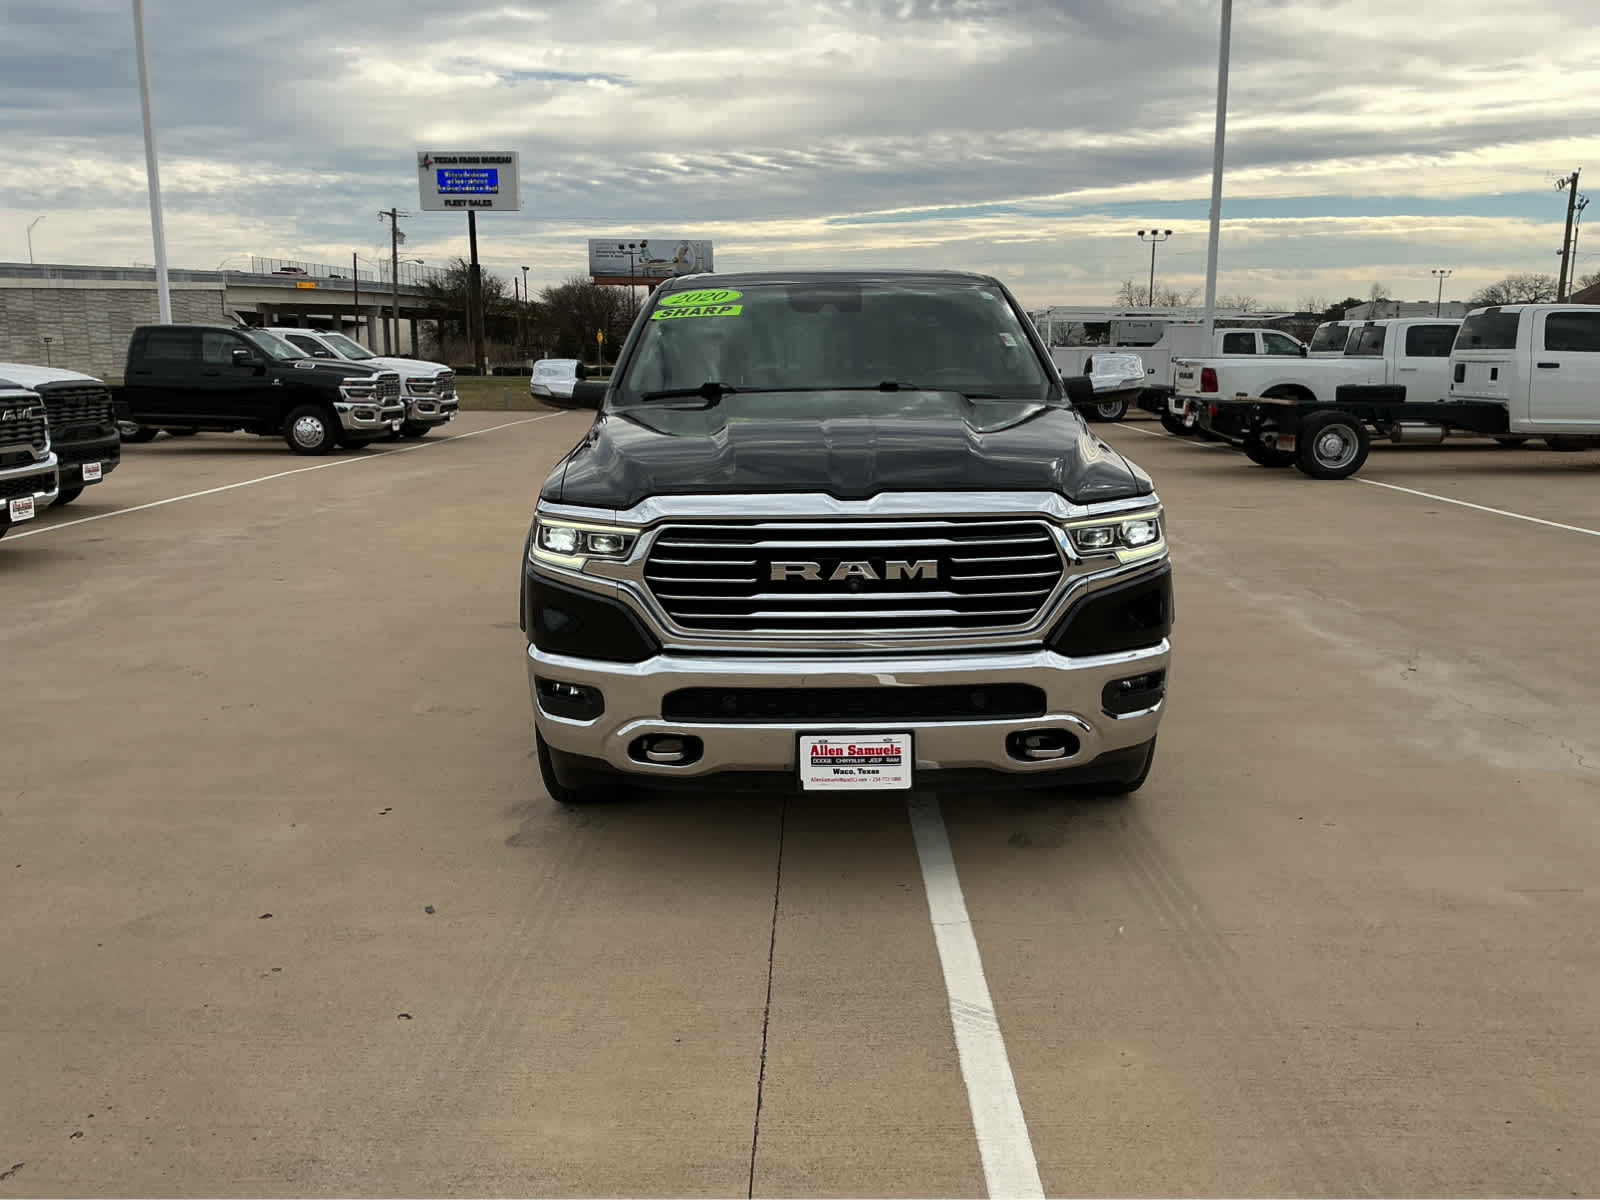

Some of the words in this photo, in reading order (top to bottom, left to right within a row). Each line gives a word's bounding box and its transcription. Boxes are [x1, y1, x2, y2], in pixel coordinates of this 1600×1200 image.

[433, 156, 457, 164] TEXAS
[458, 156, 480, 164] FARM
[481, 156, 512, 164] BUREAU
[671, 291, 729, 304] 2020
[659, 306, 733, 318] SHARP
[770, 560, 938, 581] RAM
[810, 744, 844, 756] Allen
[847, 743, 902, 756] Samuels
[832, 768, 856, 776] Waco,
[857, 767, 880, 775] Texas
